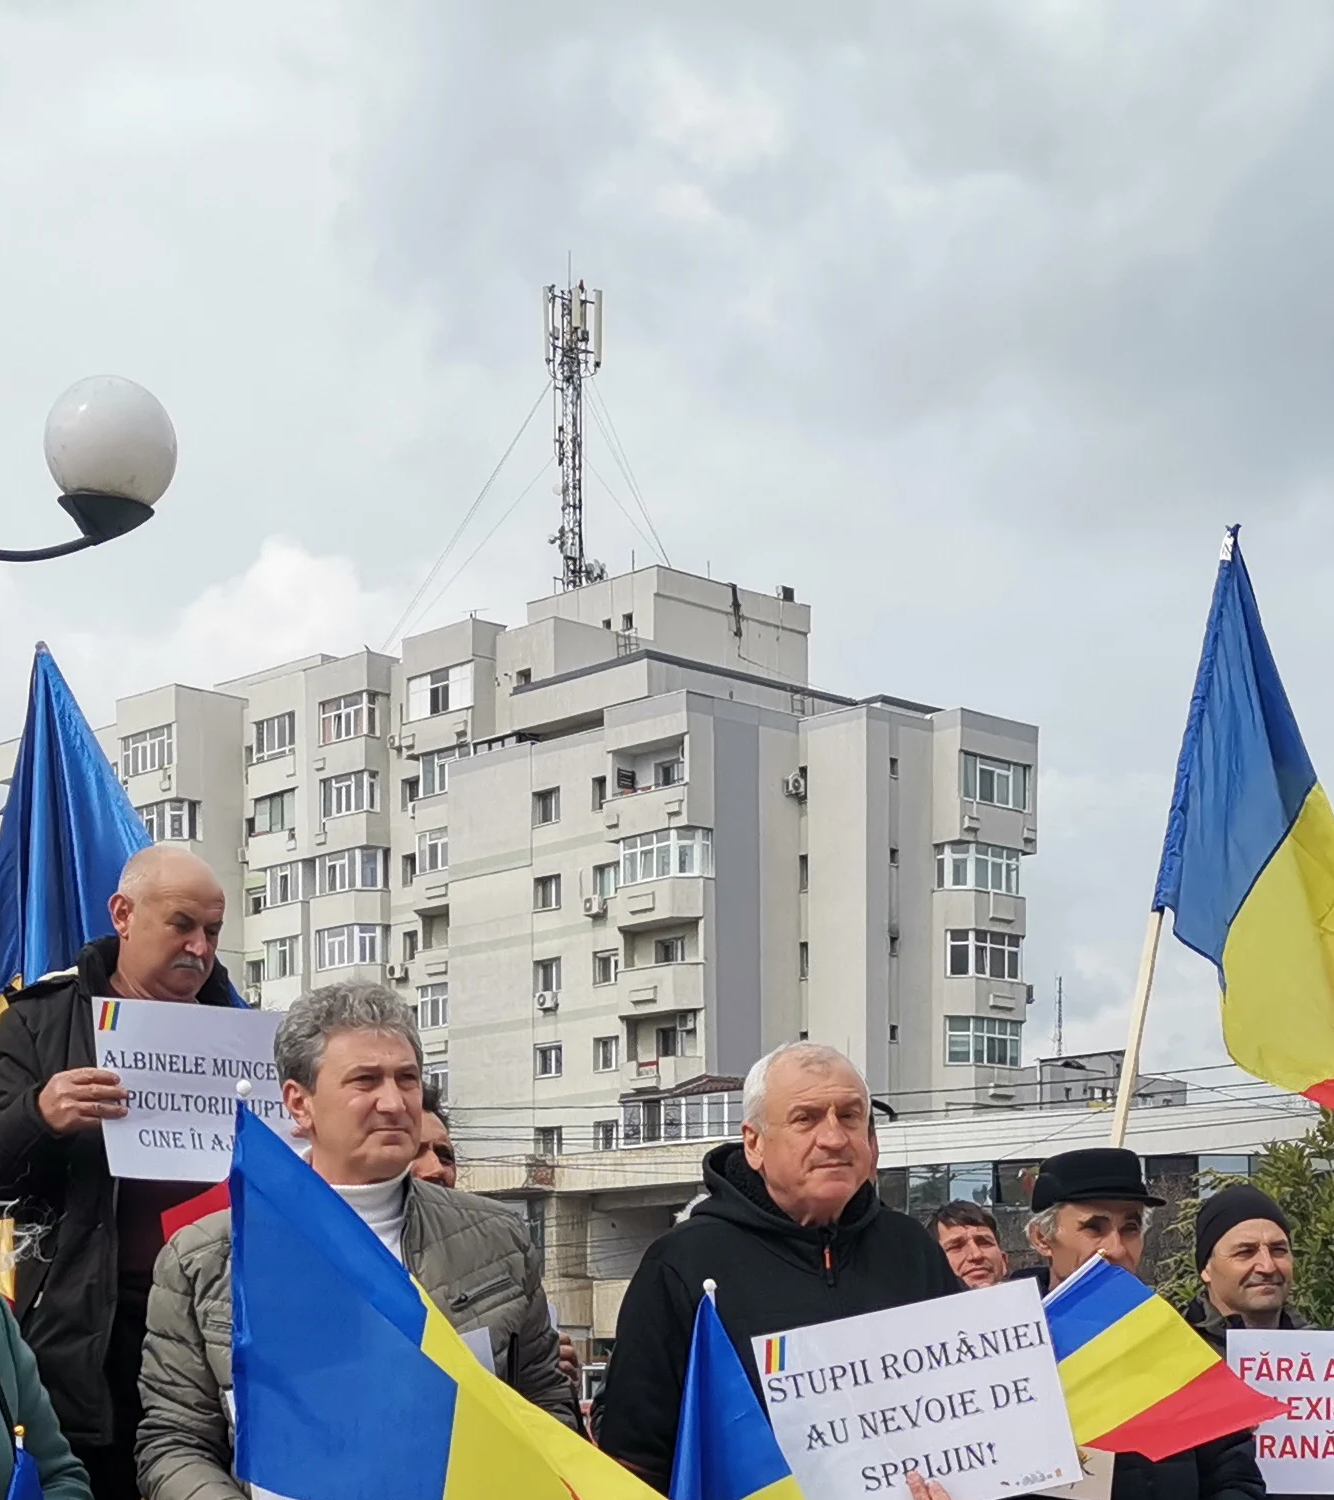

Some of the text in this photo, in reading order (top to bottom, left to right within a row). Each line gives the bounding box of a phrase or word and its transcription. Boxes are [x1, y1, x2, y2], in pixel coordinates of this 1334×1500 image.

[102, 1050, 277, 1080] ALBINELE MUNCE
[118, 1089, 233, 1116] PICULTORII
[139, 1129, 185, 1149] CINE
[191, 1127, 204, 1149] ÎI
[768, 1320, 1047, 1404] STUPII ROMÂNIEI
[1239, 1351, 1315, 1382] FĂRĂ
[806, 1377, 1039, 1451] AU NEVOIE DE
